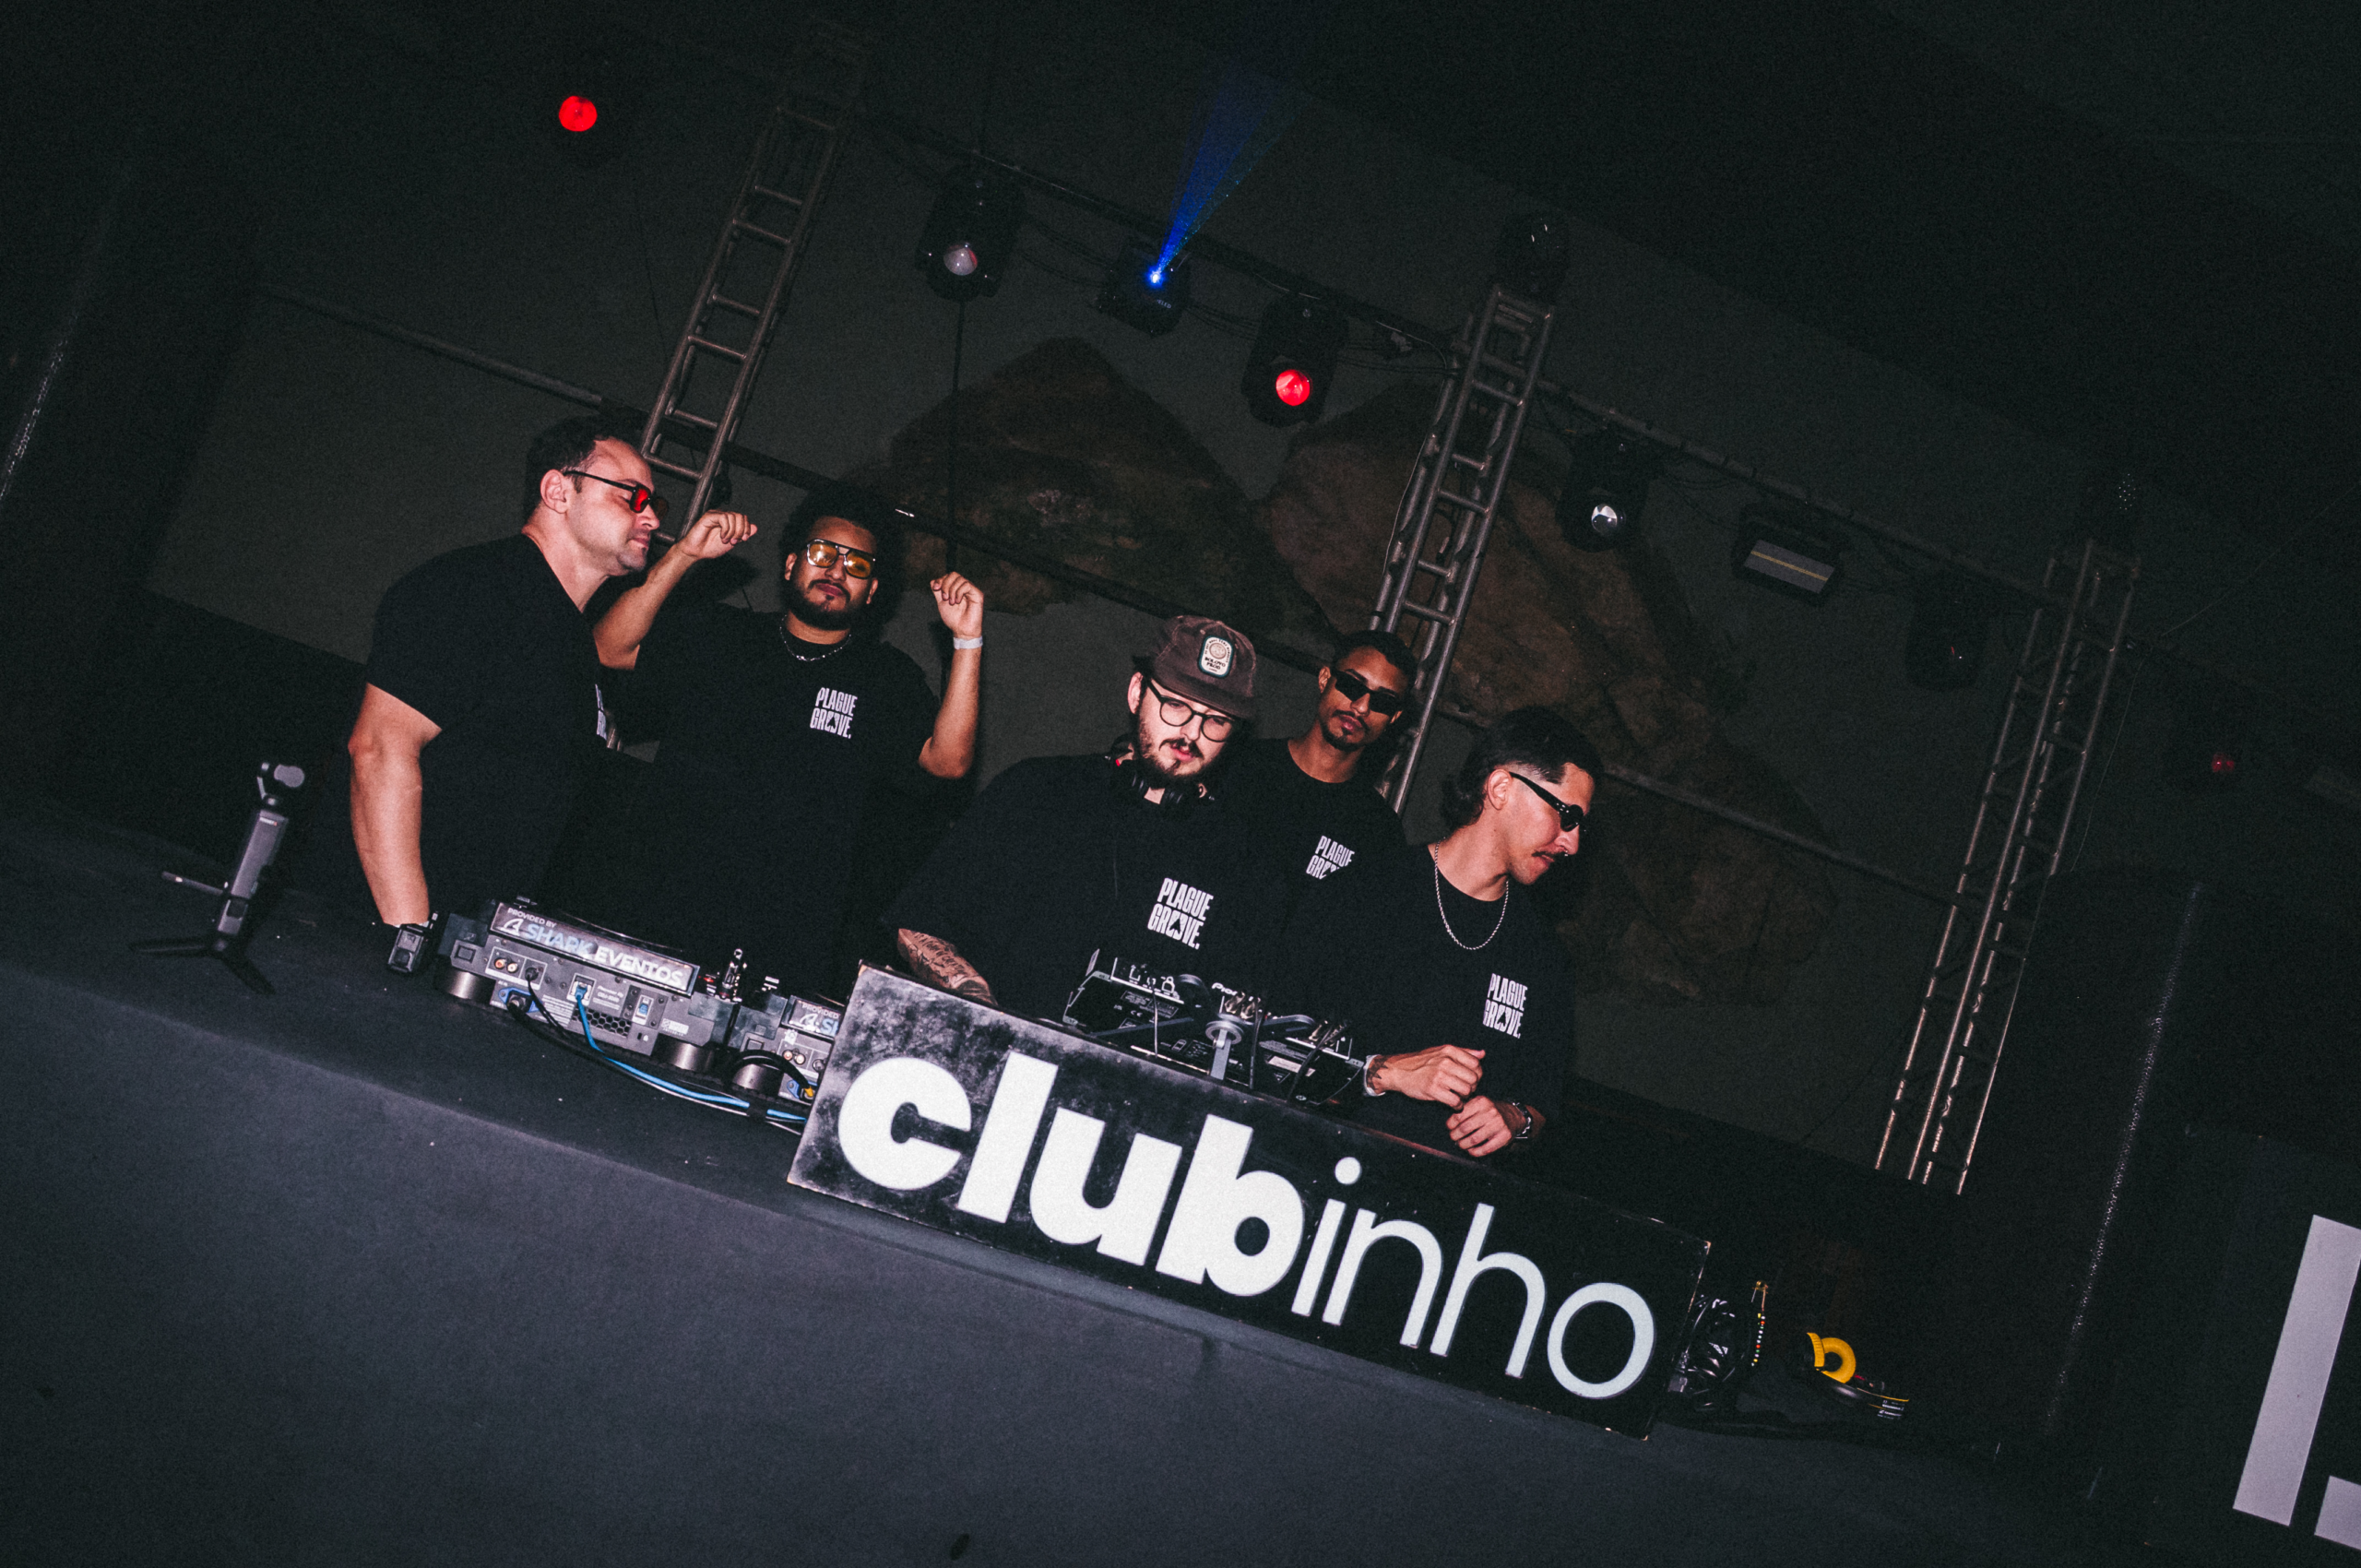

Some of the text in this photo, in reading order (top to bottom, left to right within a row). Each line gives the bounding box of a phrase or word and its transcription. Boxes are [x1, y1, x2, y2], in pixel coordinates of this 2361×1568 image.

[814, 687, 858, 717] PLAGUE
[1314, 835, 1356, 867] PLAGUE
[1157, 877, 1214, 921] PLAGUE
[508, 908, 557, 928] PROVIDED BY
[524, 924, 684, 991] SHARK EVENTOS
[1487, 973, 1528, 1012] PLAGUE
[802, 1003, 839, 1019] PROVIDED
[836, 1051, 1656, 1399] clubinho
